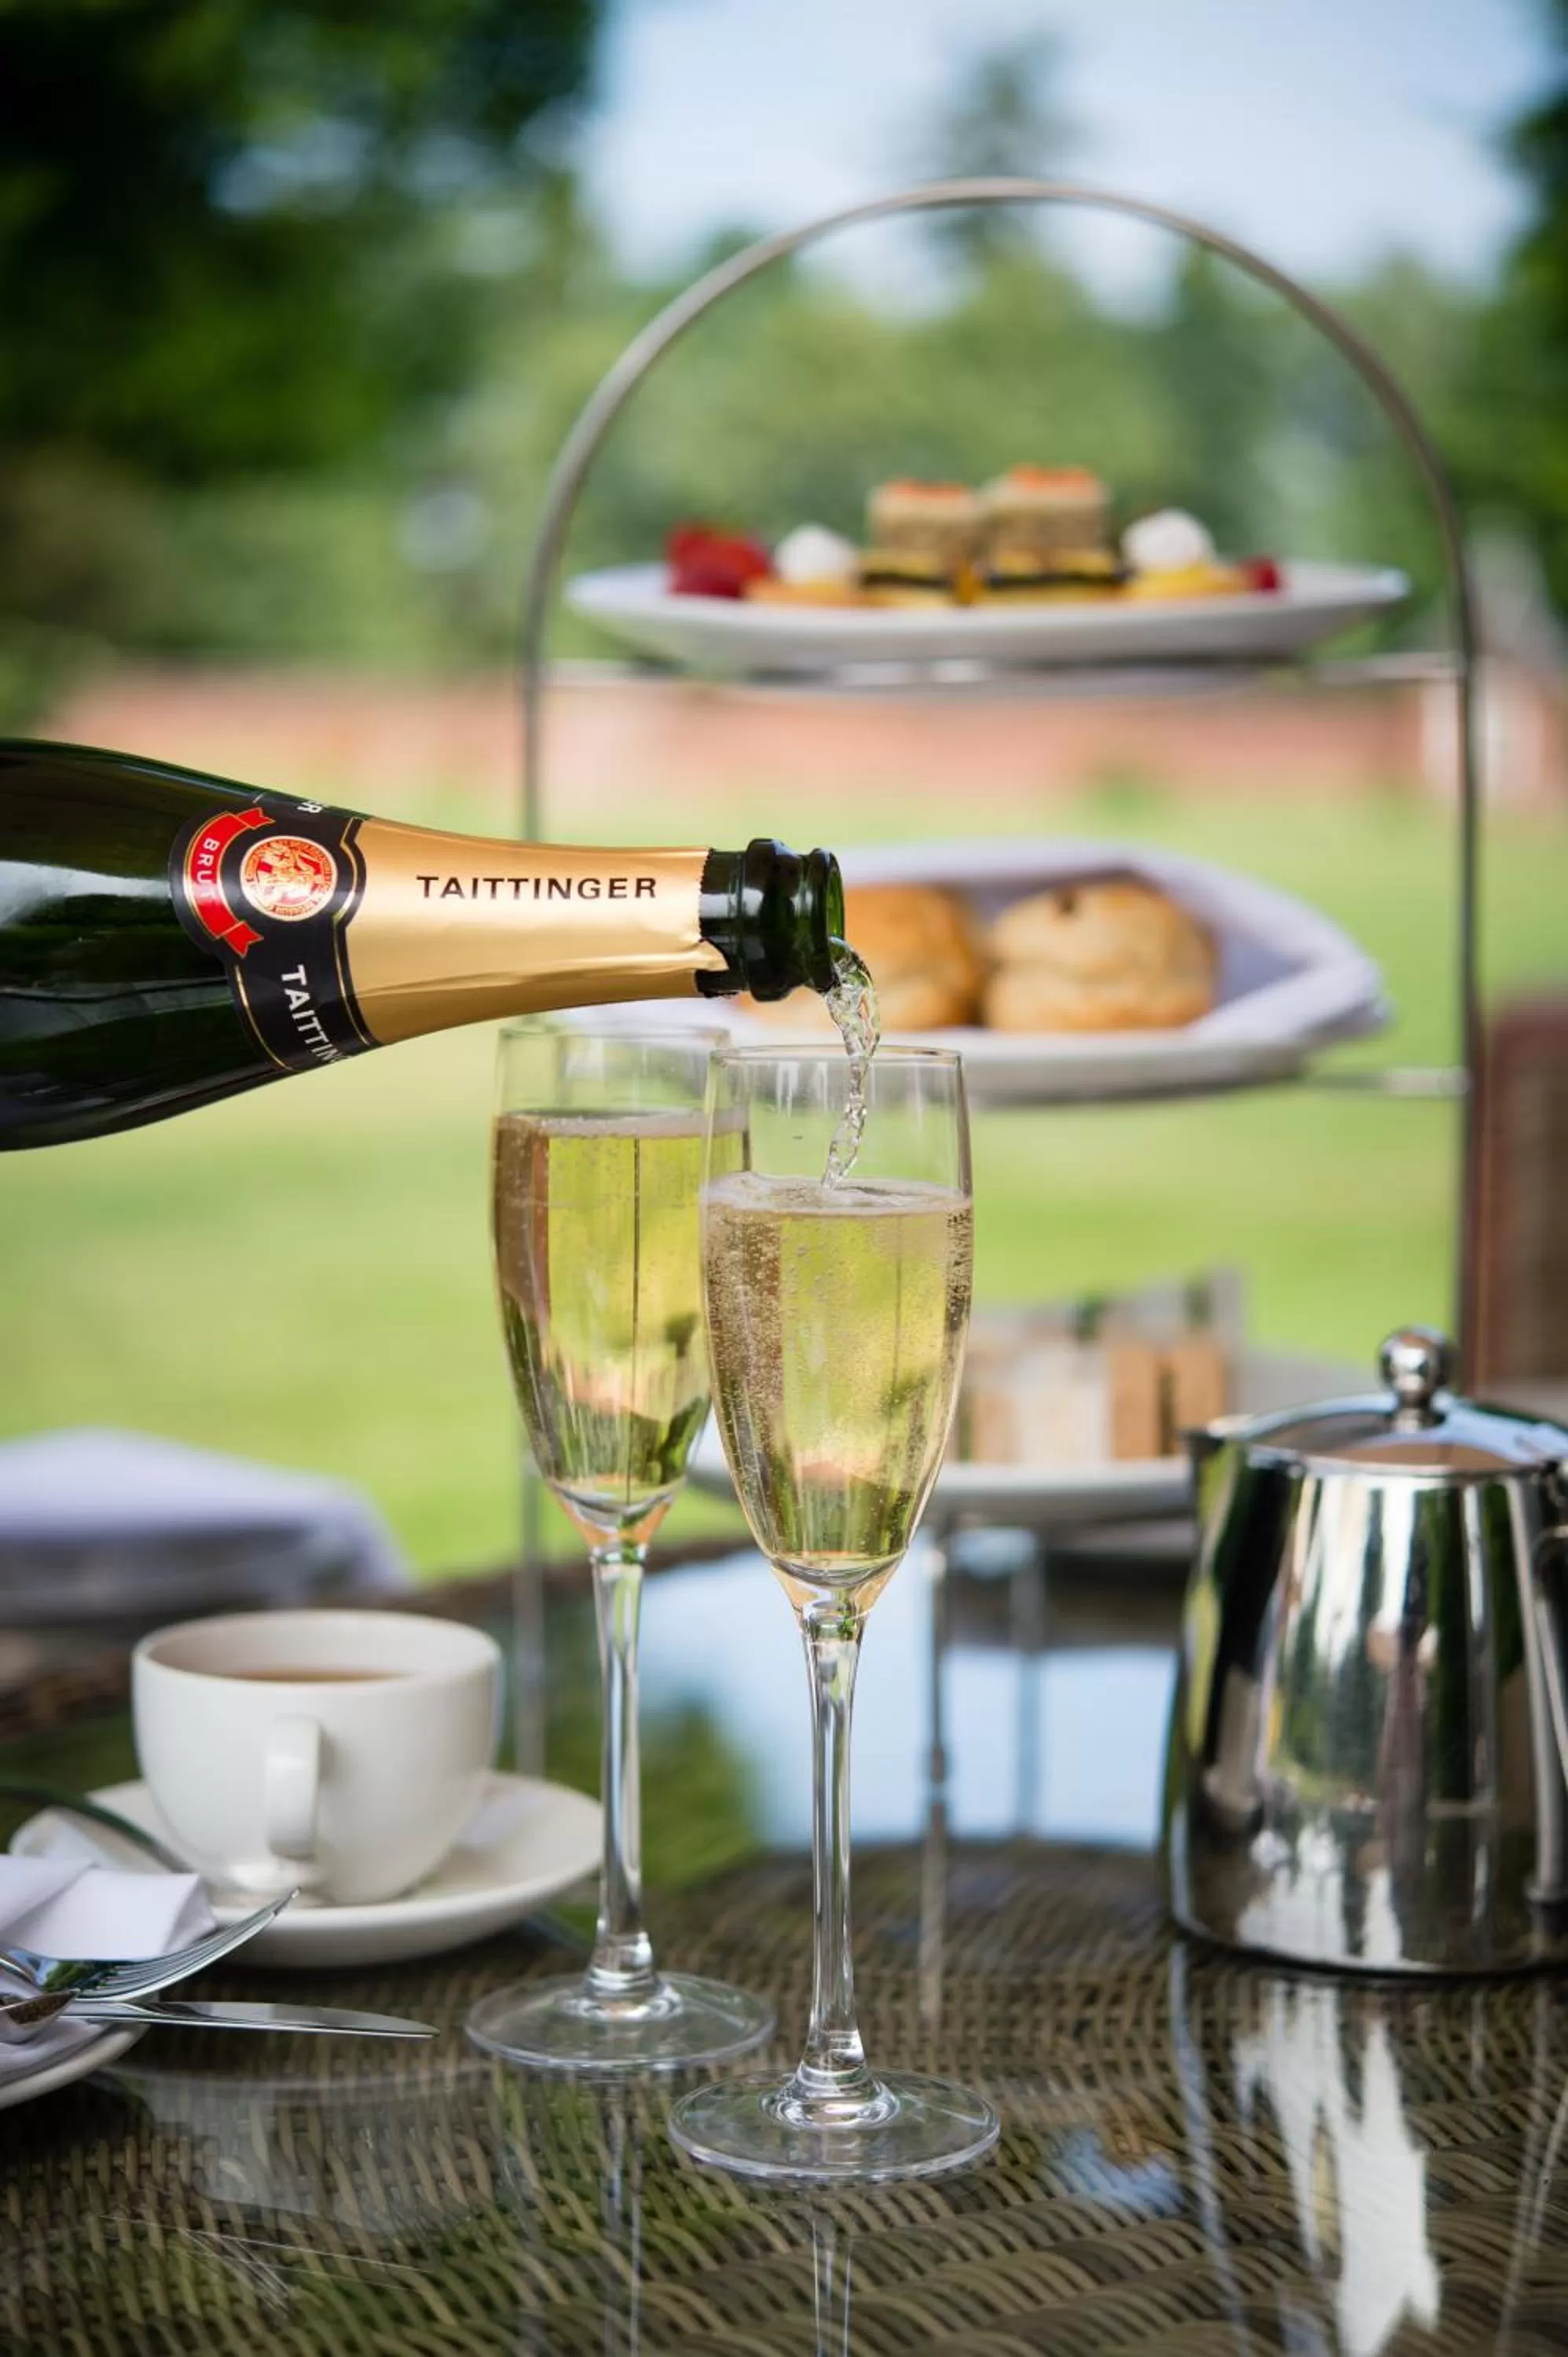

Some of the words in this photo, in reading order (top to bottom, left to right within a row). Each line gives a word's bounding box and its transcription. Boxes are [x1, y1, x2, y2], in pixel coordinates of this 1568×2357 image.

[197, 838, 221, 903] BRUT
[416, 875, 658, 900] TAITTINGER
[280, 963, 343, 1063] TAITTIN
